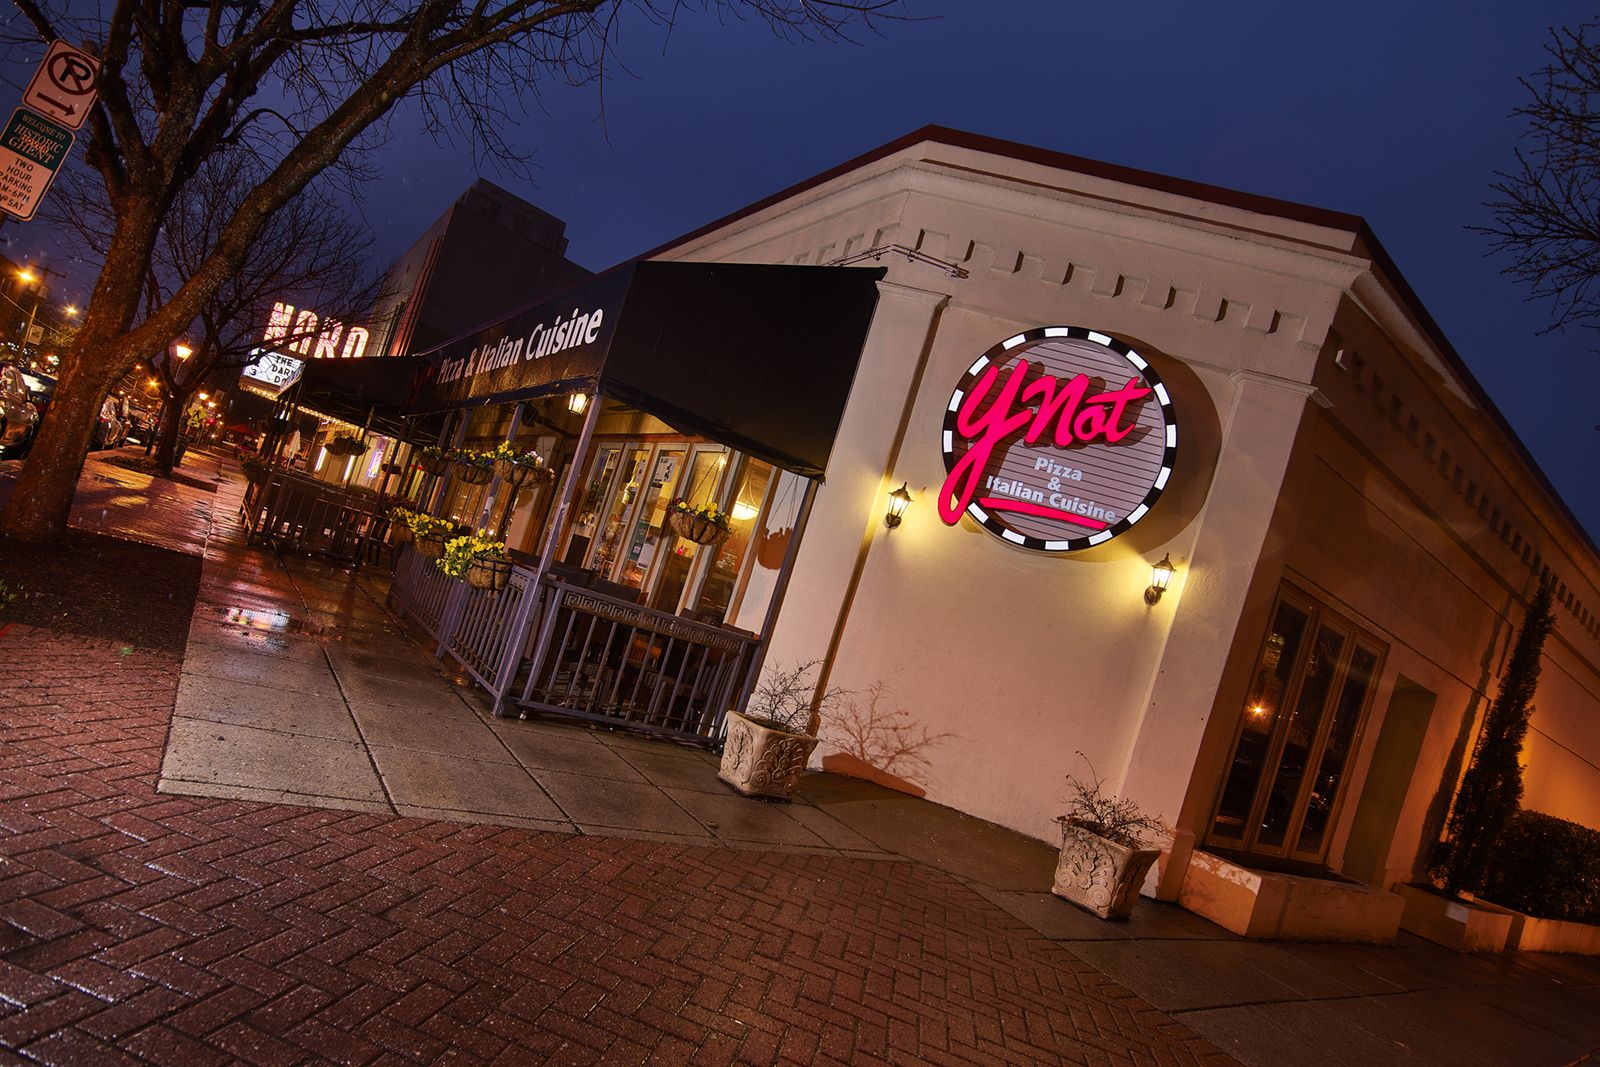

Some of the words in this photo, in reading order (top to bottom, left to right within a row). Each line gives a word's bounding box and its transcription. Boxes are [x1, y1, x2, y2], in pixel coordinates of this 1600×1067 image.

[14, 123, 63, 154] HISTORIC
[22, 114, 56, 137] WELCOME
[56, 131, 65, 141] TO
[8, 136, 54, 164] GHENT
[6, 165, 32, 182] HOUR
[15, 157, 34, 172] TWO
[7, 198, 24, 210] SAT
[435, 357, 465, 385] Pizza
[465, 348, 477, 378] &
[475, 335, 524, 375] Italian
[525, 307, 603, 361] Cuisine
[275, 355, 293, 367] THE
[1034, 457, 1083, 481] Pizza
[1047, 477, 1061, 492] &
[986, 475, 1044, 503] Italian
[1049, 493, 1116, 522] Cuisine
